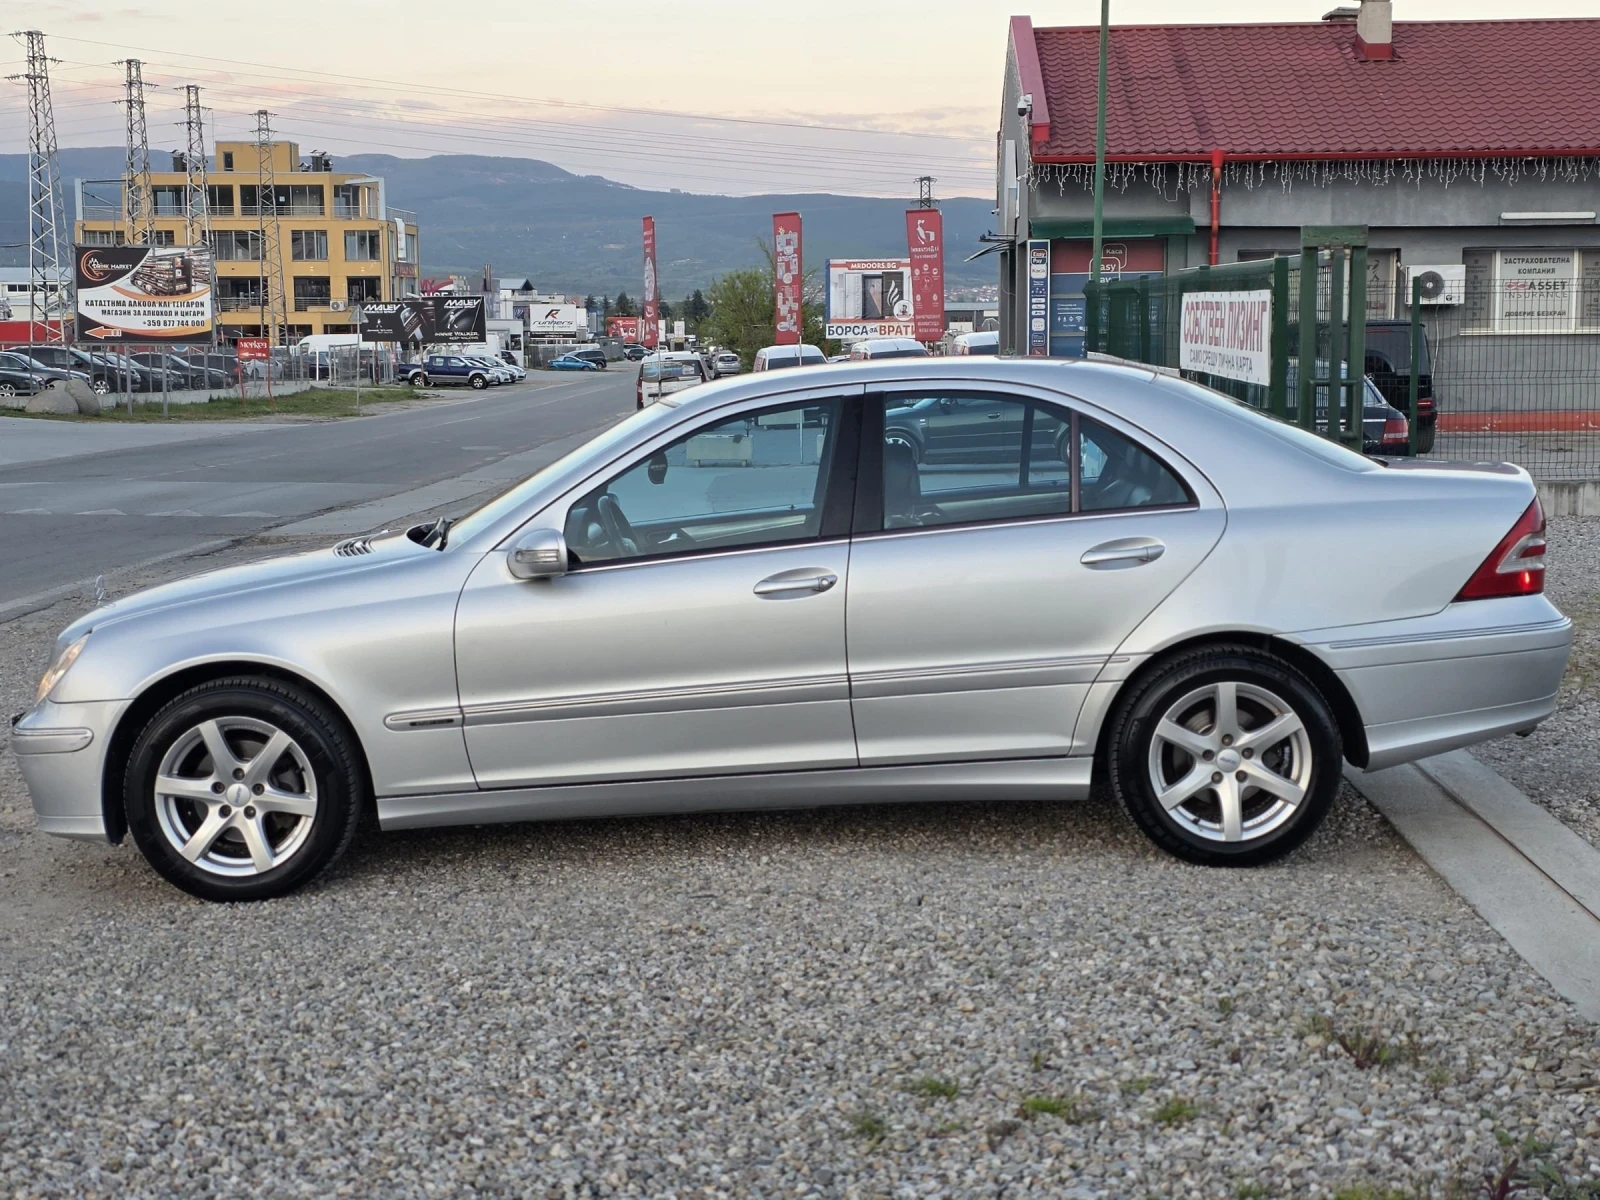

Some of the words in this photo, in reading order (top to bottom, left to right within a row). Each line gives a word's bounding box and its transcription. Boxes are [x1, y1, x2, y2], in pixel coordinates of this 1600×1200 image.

[1528, 281, 1568, 290] ASSET
[828, 326, 869, 336] БОРСА
[1184, 301, 1226, 347] СОБСТВЕН
[1226, 301, 1267, 352] ЛИЗИНГ
[1190, 349, 1202, 364] САМО
[1203, 350, 1218, 366] СРЕЩУ
[1236, 356, 1253, 374] КАРТА
